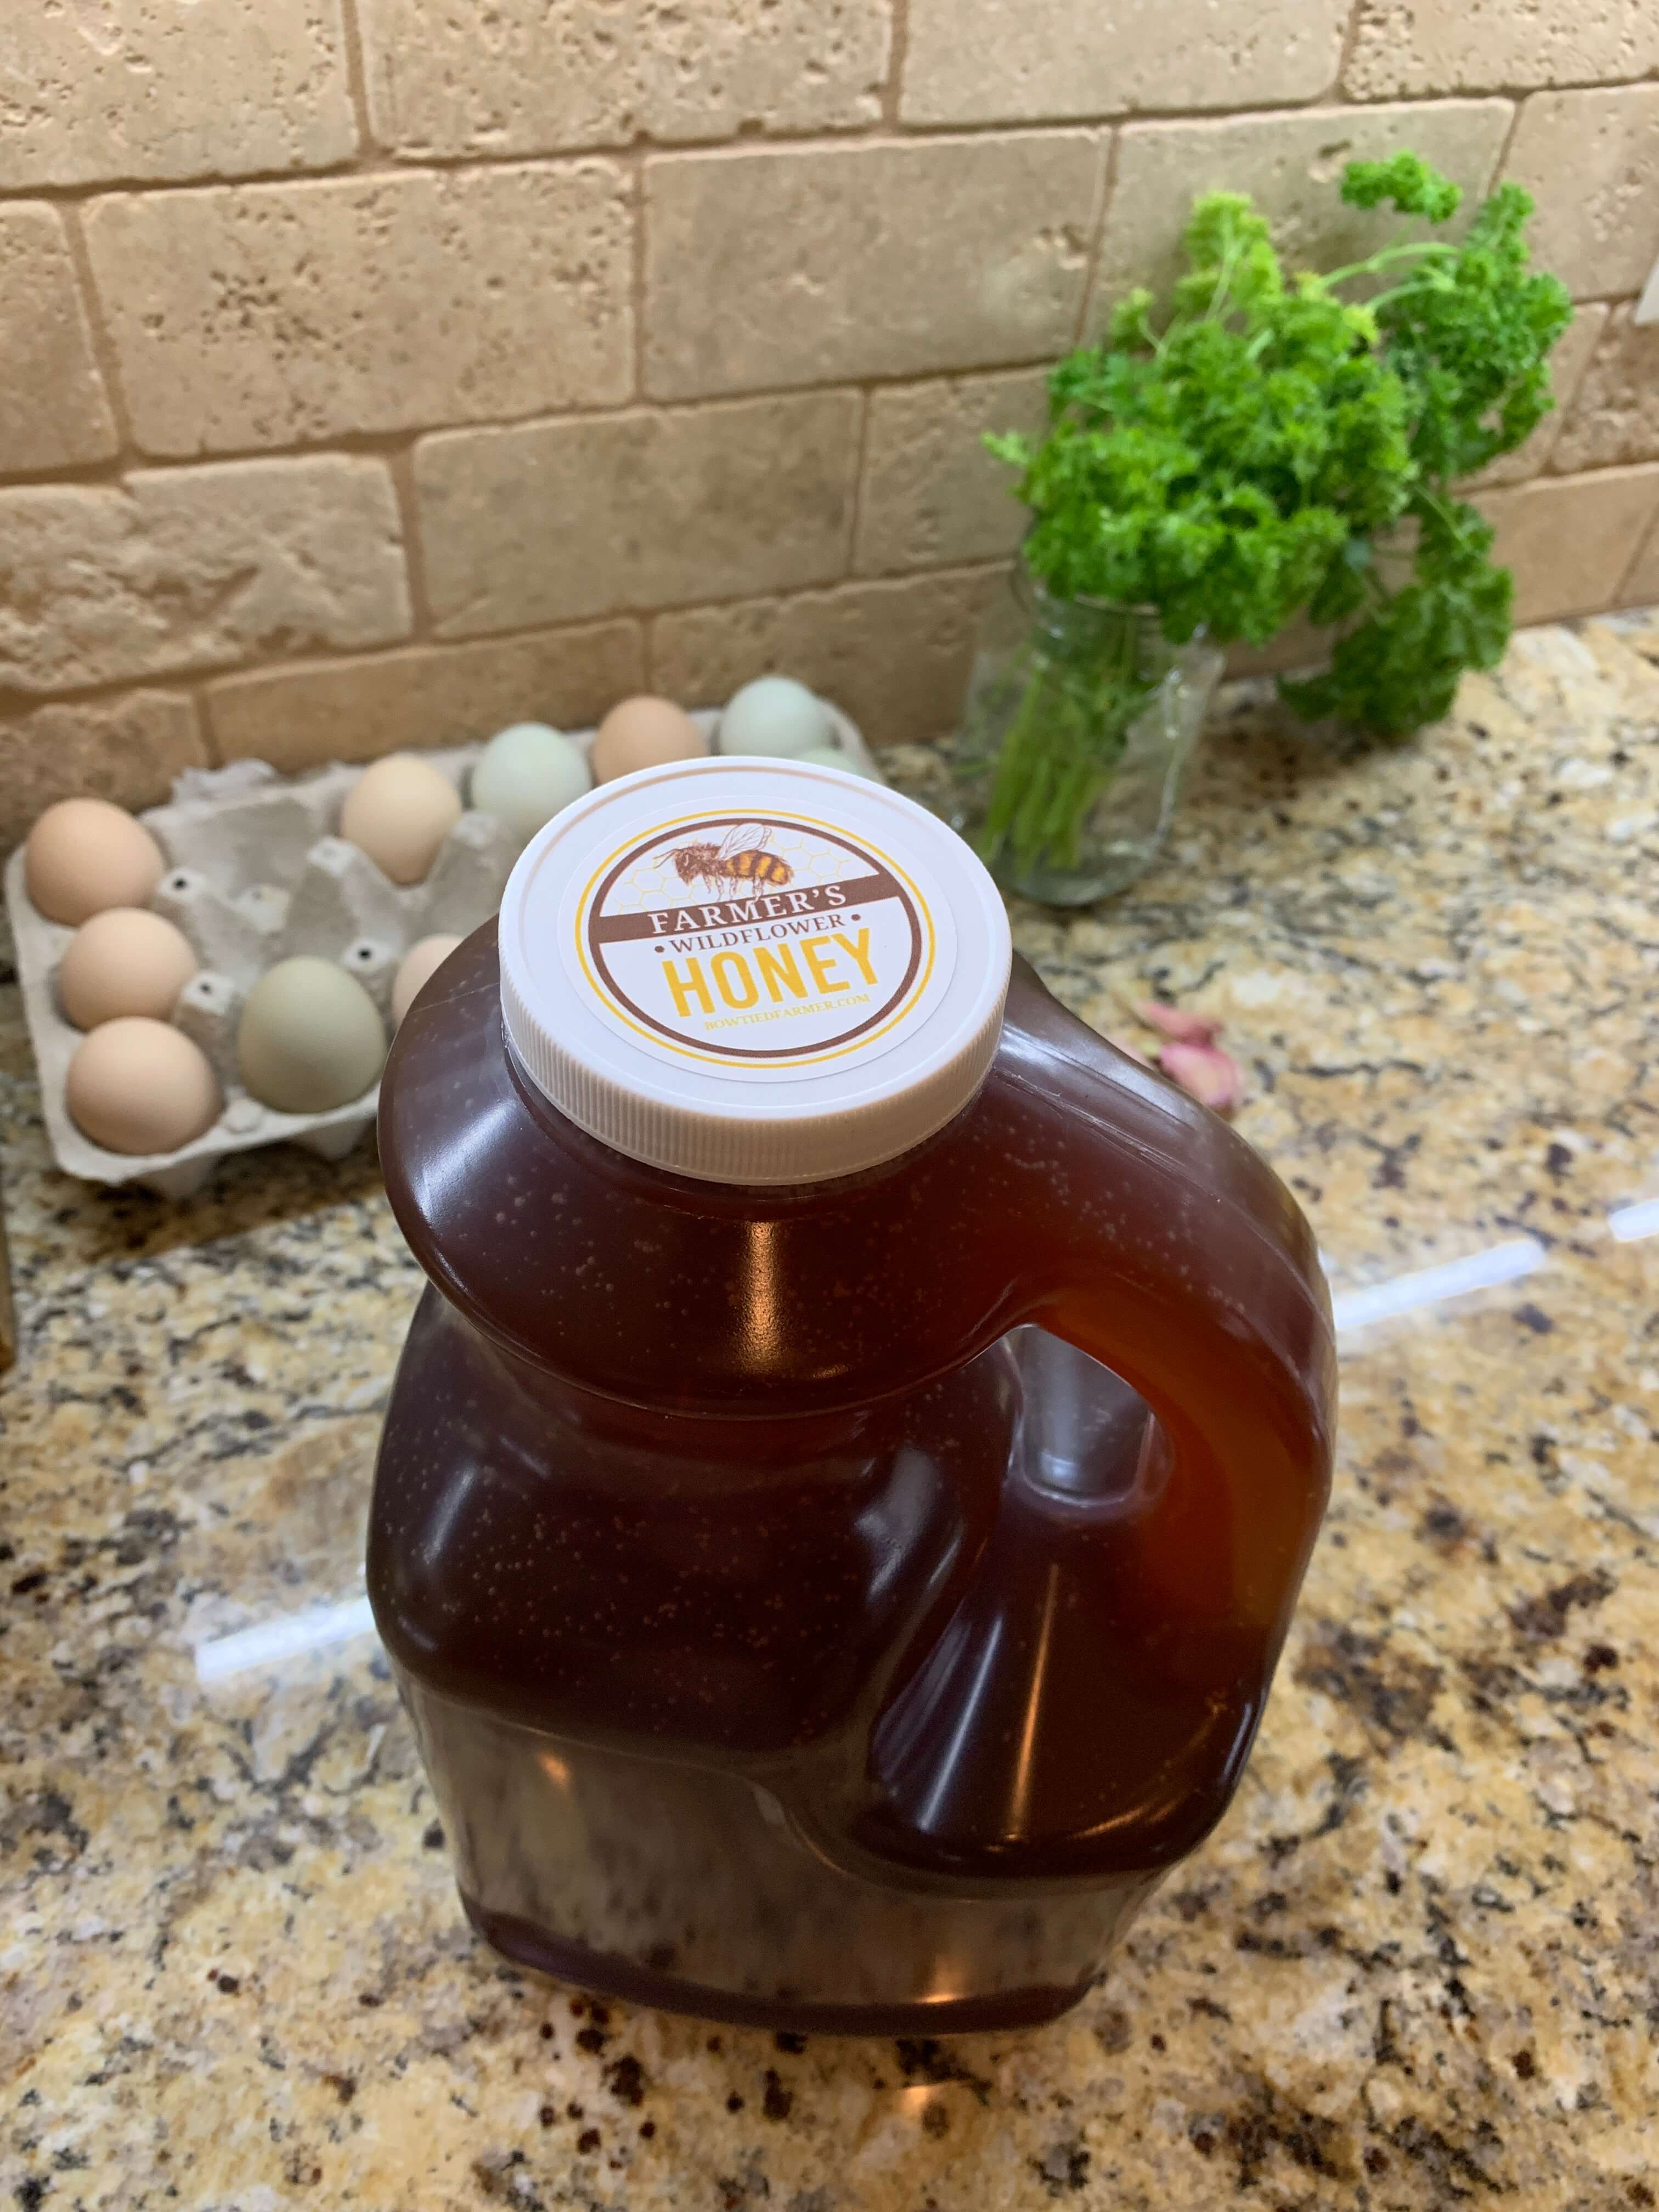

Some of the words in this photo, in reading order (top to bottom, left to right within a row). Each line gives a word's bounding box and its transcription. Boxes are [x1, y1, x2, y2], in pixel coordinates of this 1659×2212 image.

[648, 885, 847, 934] FARMER'S
[669, 913, 845, 953] WILDFLOWER
[662, 928, 878, 1017] HONEY
[704, 994, 870, 1031] BOWTIEDFARMER.COM
